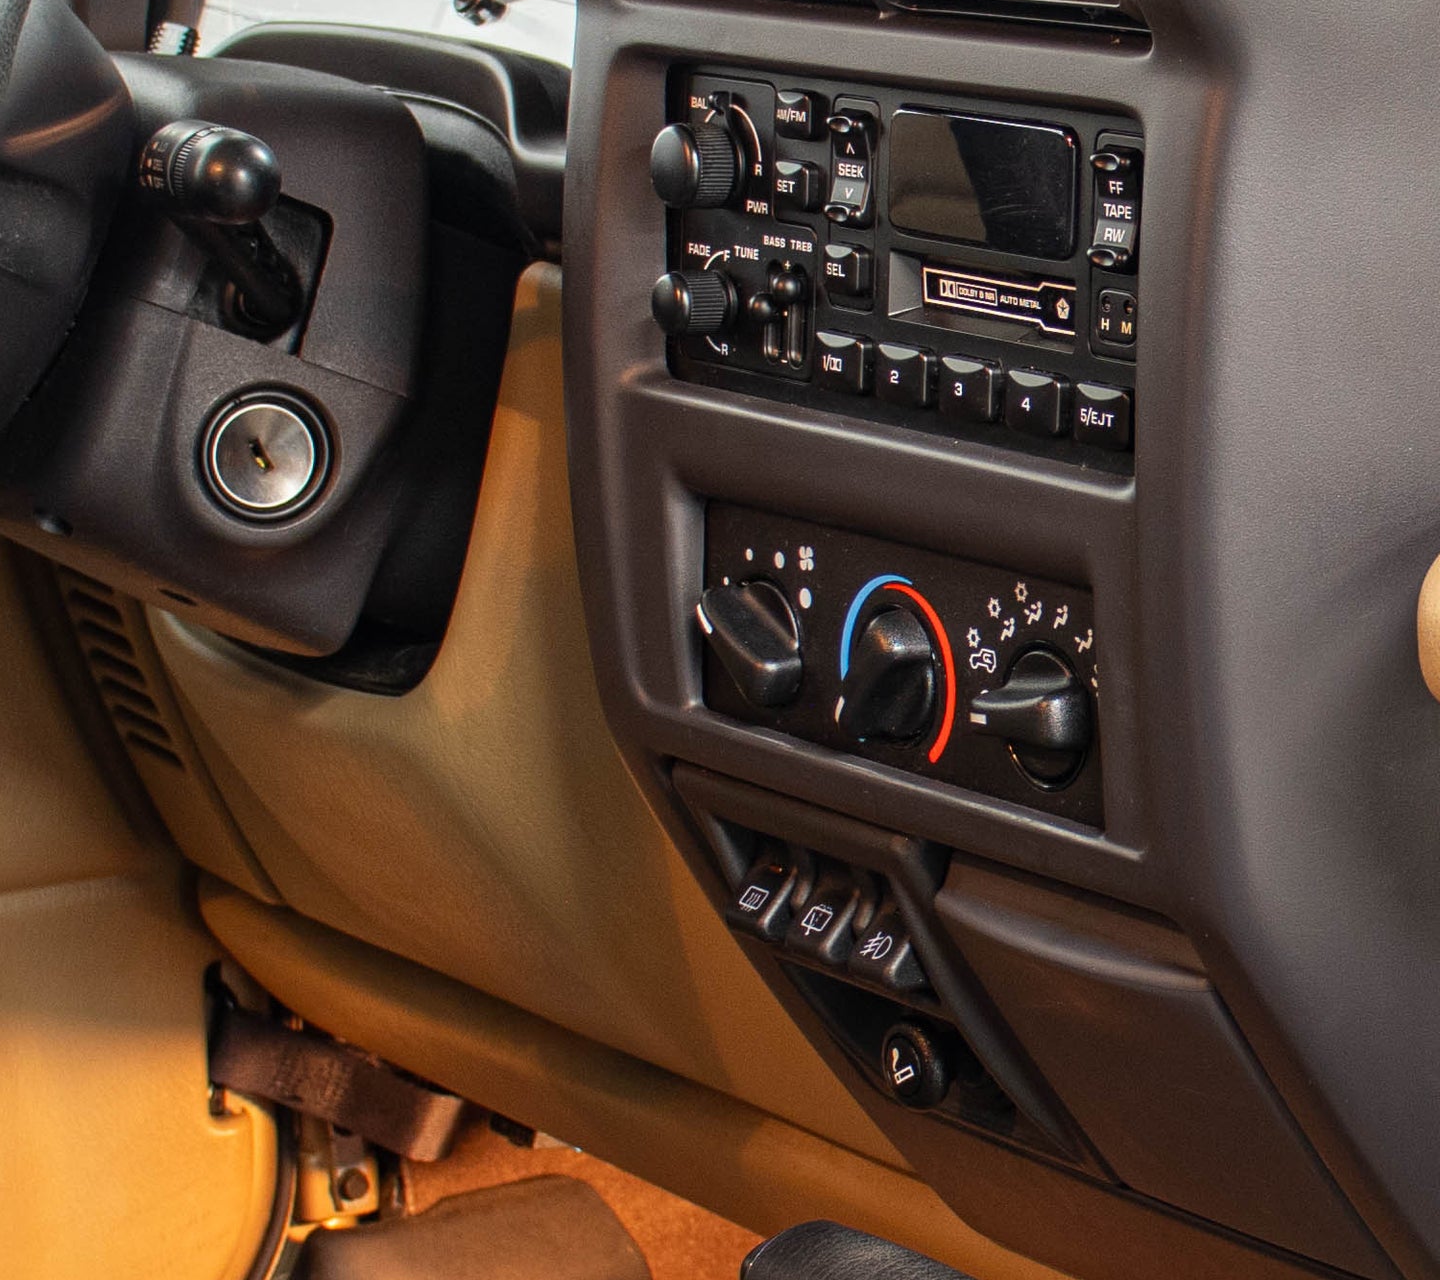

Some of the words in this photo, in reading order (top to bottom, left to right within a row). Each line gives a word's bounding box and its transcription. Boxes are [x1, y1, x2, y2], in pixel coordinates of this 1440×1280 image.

[690, 96, 708, 109] BAL
[776, 107, 806, 122] AM/FM
[755, 163, 763, 176] R
[838, 163, 864, 178] SEEK
[776, 179, 795, 193] SET
[1109, 180, 1124, 195] FF
[746, 200, 768, 214] PWR
[1103, 203, 1132, 219] TAPE
[1103, 227, 1125, 242] RW
[763, 235, 786, 249] BASS
[790, 239, 813, 253] TREB
[688, 242, 711, 257] FADE
[723, 250, 730, 262] F
[734, 245, 760, 260] TUNE
[826, 262, 846, 277] SEL
[959, 287, 978, 298] DOLBY
[1000, 295, 1018, 306] AUTO
[1020, 298, 1042, 310] METAL
[1101, 317, 1110, 330] H
[1121, 321, 1132, 335] M
[721, 343, 729, 356] R
[890, 371, 899, 384] 2
[954, 382, 963, 397] 3
[1021, 397, 1030, 411] 4
[1080, 407, 1115, 428] 5/EJT
